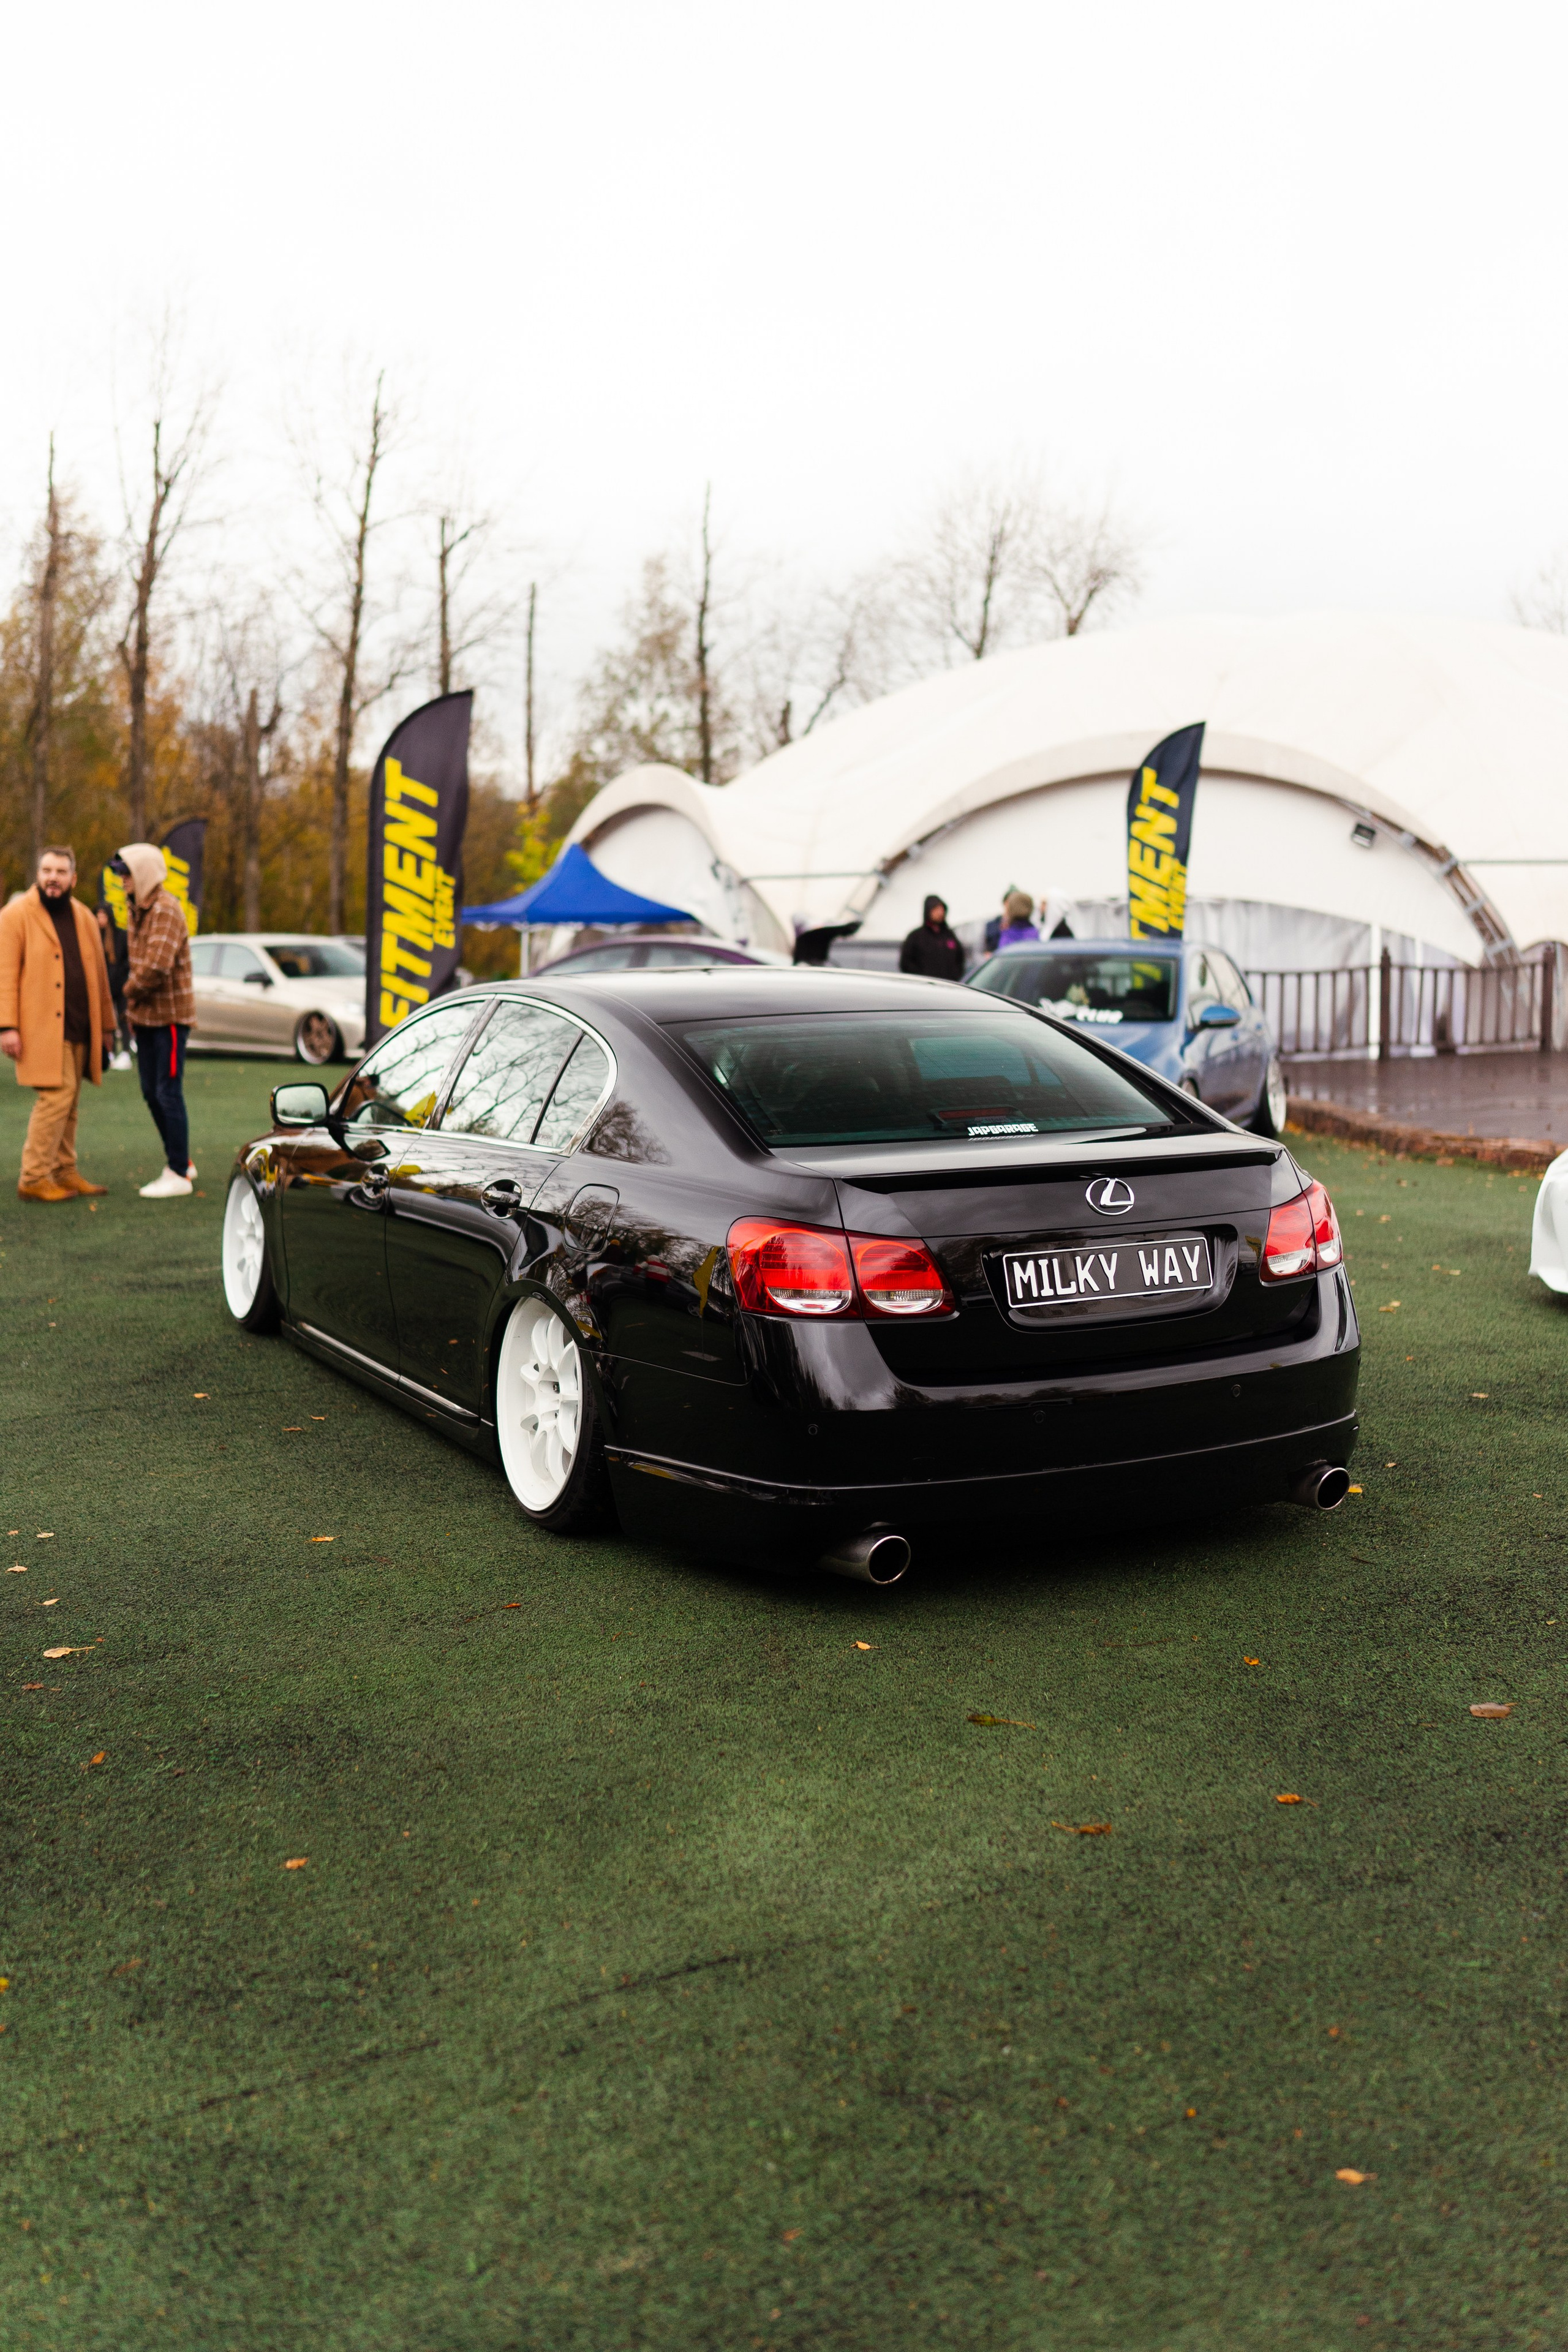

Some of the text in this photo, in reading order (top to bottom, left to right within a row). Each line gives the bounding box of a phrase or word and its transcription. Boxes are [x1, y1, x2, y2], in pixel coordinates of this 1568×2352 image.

[380, 756, 439, 1029] FITMENT
[433, 864, 456, 949] EVENT
[967, 1123, 1039, 1136] JAPGARAGE
[1012, 1245, 1200, 1299] MILKY WAY
